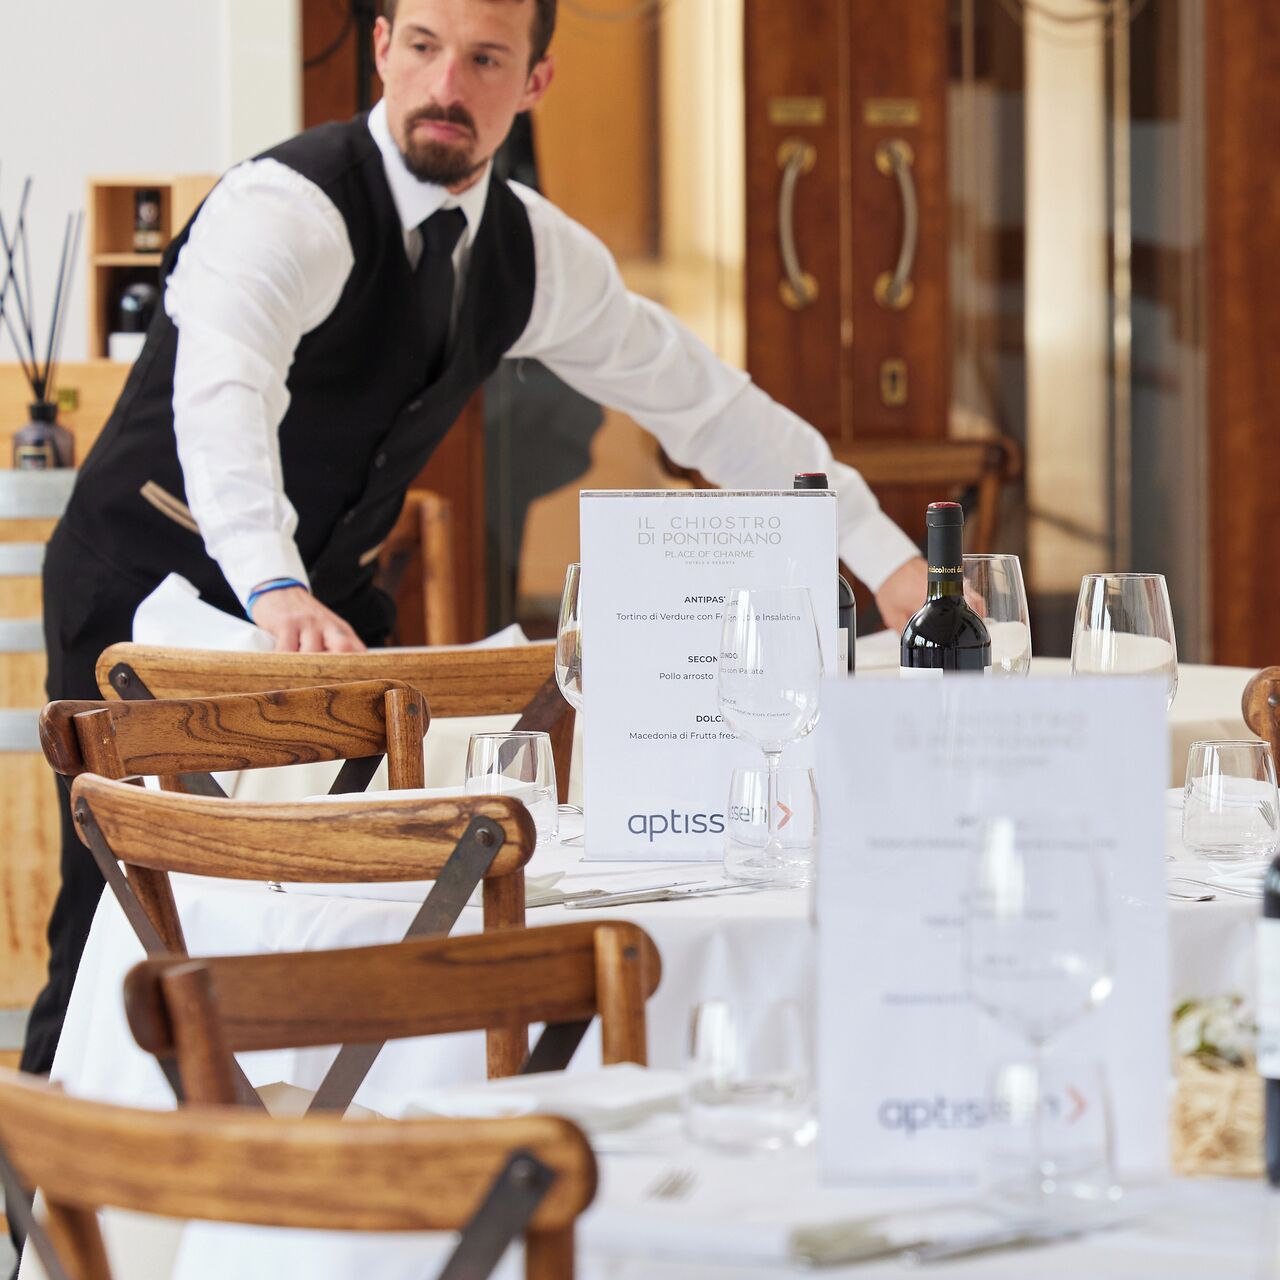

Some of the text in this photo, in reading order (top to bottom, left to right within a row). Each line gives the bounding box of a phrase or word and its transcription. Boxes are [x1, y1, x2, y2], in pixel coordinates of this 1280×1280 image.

[638, 516, 781, 529] IL CHIOSTRO
[638, 532, 782, 545] DI PONTIGNANO
[665, 550, 755, 558] PLACE OF CHARME
[616, 613, 648, 621] Tortino
[649, 612, 658, 621] di
[660, 612, 695, 621] Verdure
[762, 613, 801, 621] Insalatina
[659, 672, 681, 680] Pollo
[683, 672, 714, 680] arrosto
[696, 715, 724, 723] DOLC
[629, 732, 678, 740] Macedonia
[679, 731, 688, 740] di
[690, 732, 717, 740] Frutta
